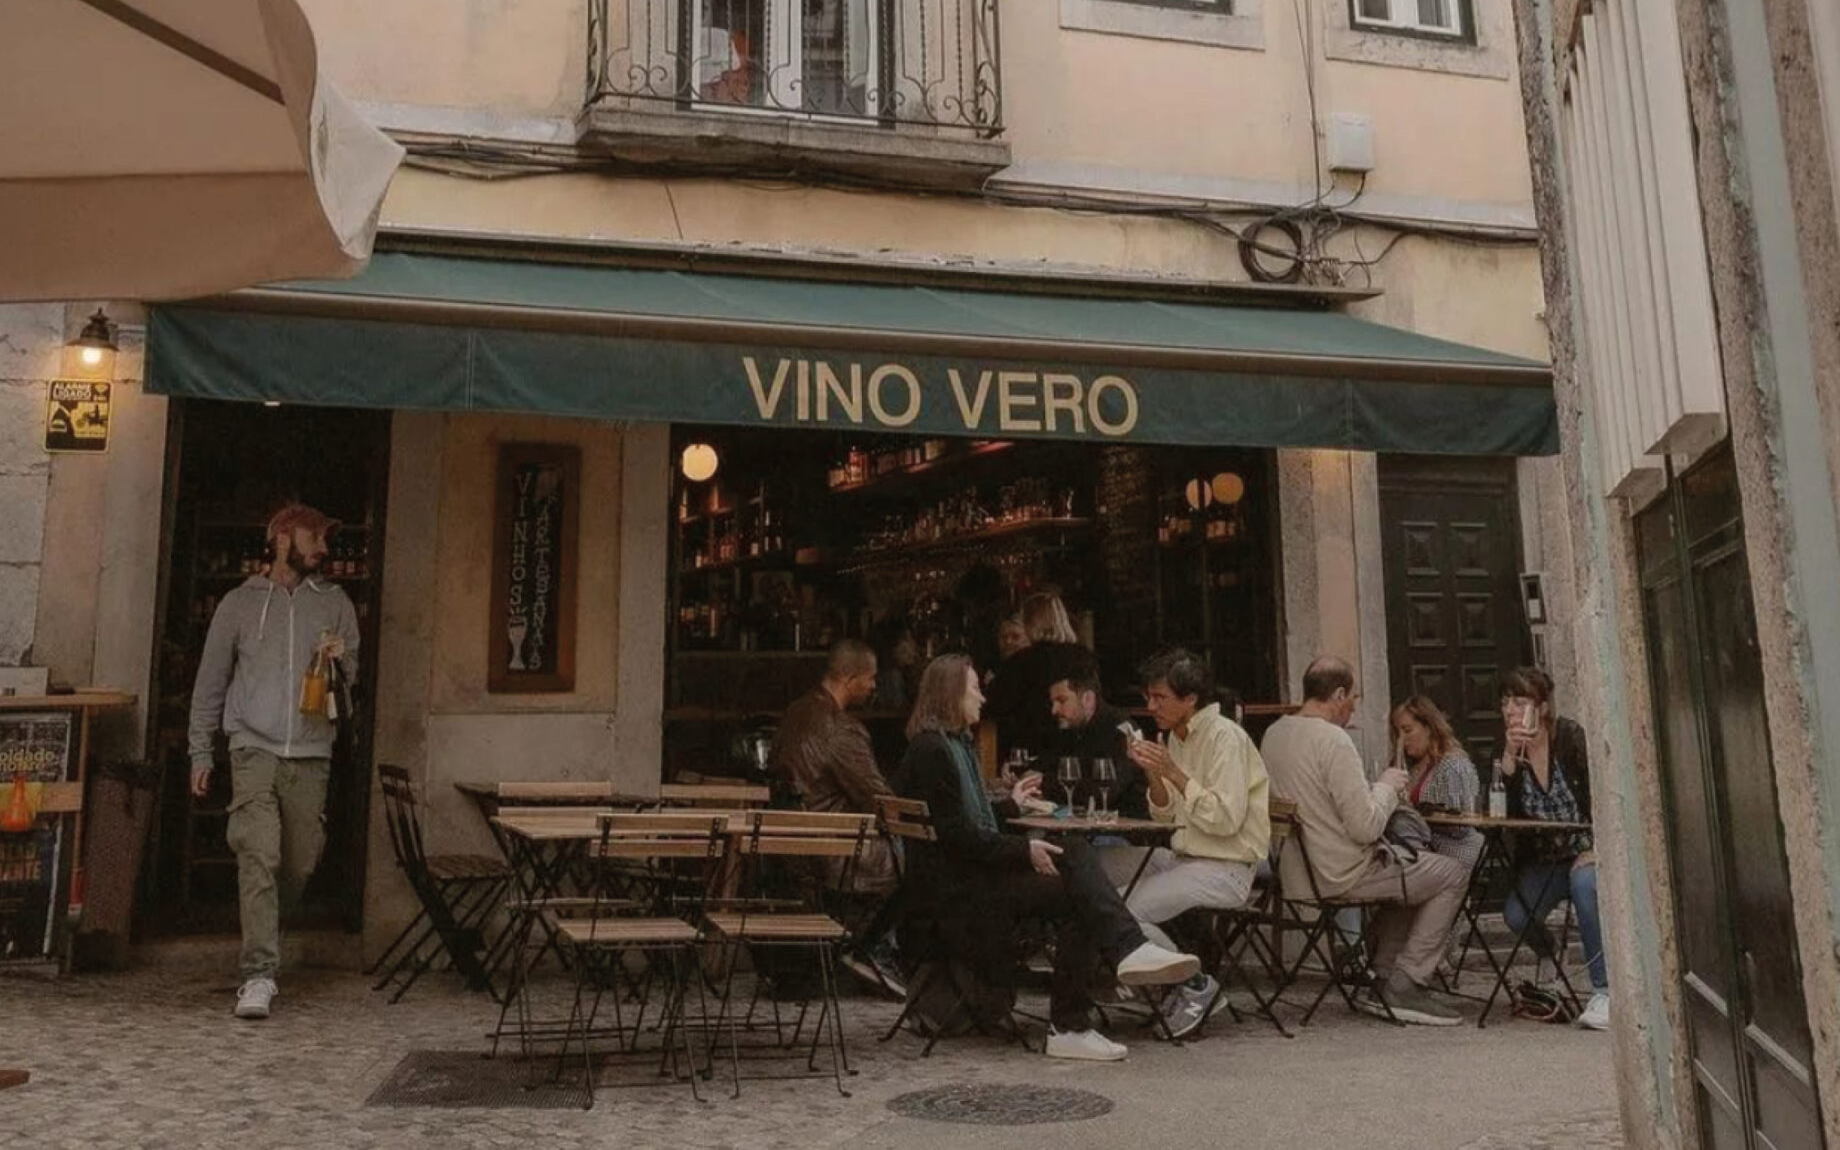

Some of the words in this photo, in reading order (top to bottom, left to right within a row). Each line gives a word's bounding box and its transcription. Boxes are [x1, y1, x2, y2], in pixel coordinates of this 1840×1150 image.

[743, 357, 921, 427] VINO
[948, 369, 1139, 436] VERO
[509, 472, 532, 605] VINHOS
[1184, 1002, 1202, 1018] N
